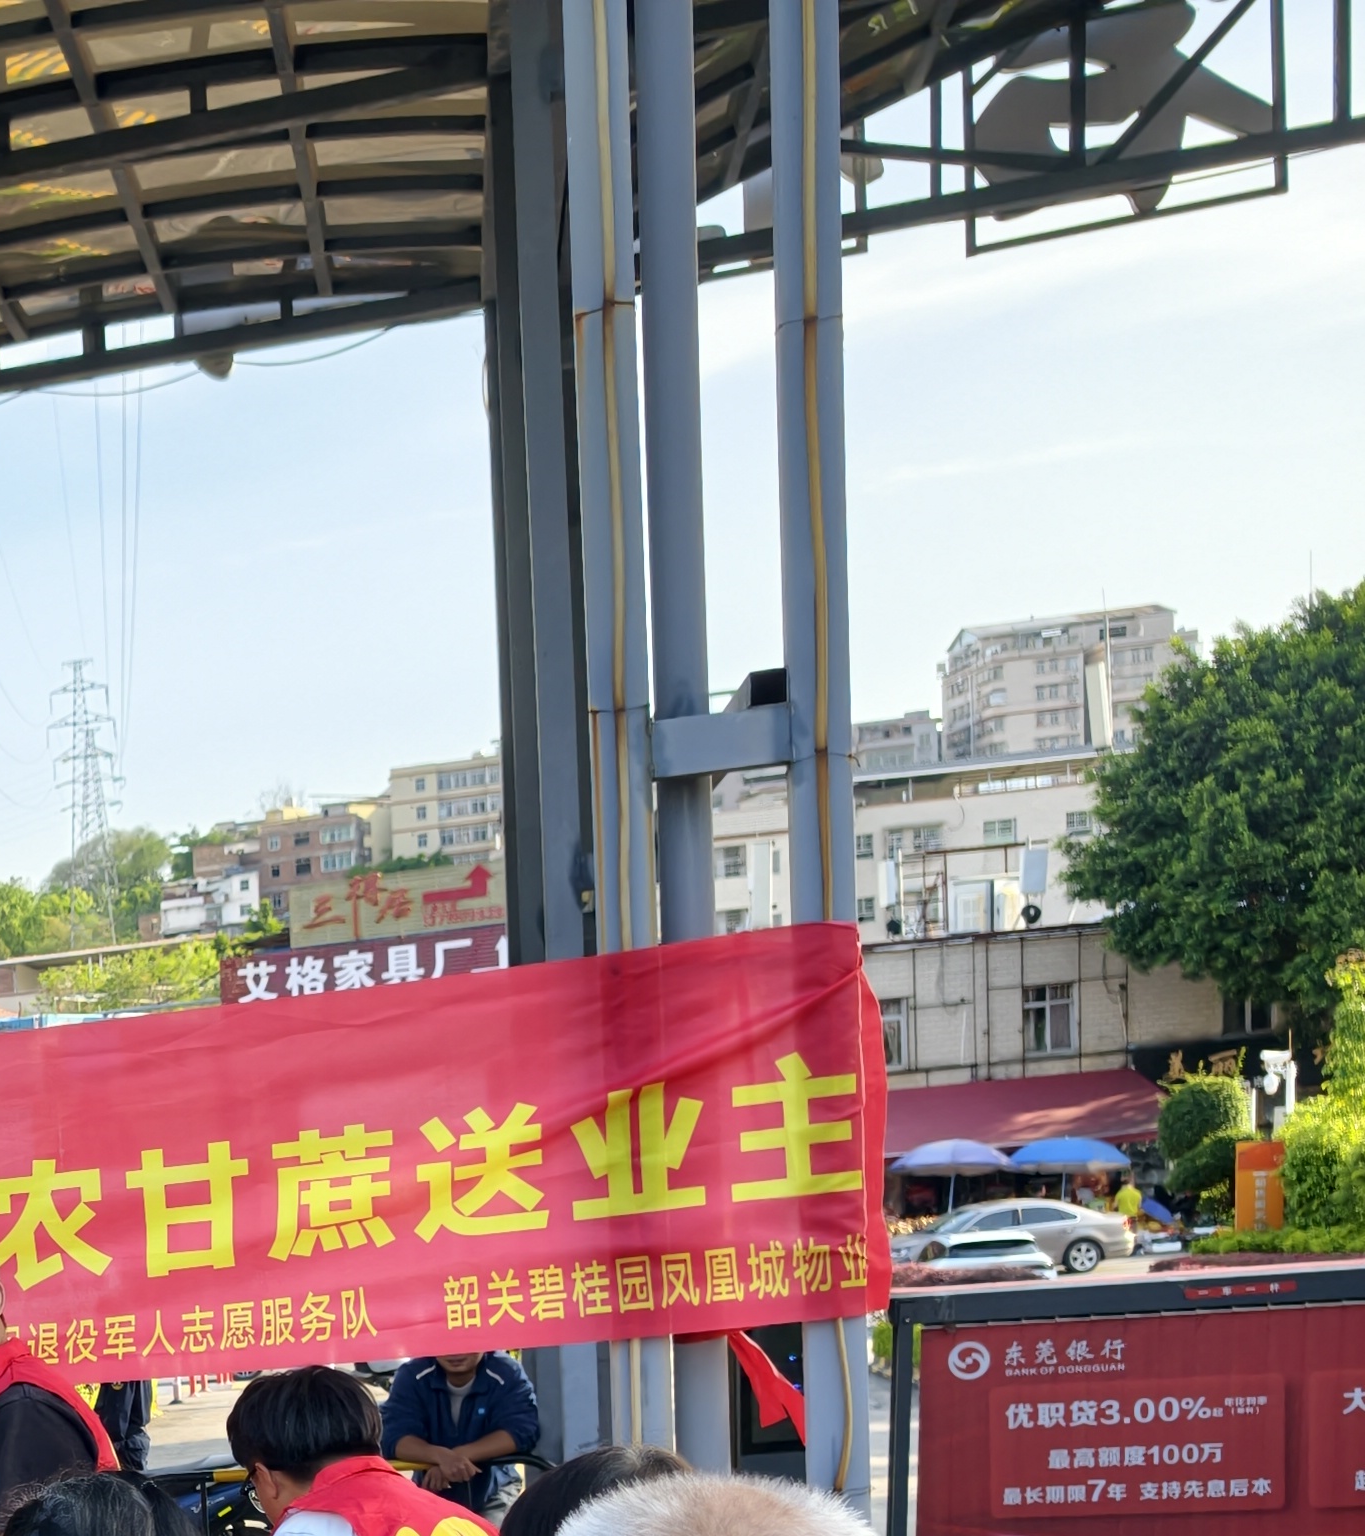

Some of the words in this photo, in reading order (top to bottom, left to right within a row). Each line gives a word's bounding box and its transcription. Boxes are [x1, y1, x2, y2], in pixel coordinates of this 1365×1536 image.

[237, 937, 473, 1004] 艾格家具厂
[443, 1233, 867, 1330] 韶关碧桂园凤凰城物业
[1004, 1339, 1126, 1366] 东莞银行
[1005, 1366, 1037, 1377] BANK
[1040, 1365, 1055, 1375] OF
[1058, 1362, 1125, 1374] DONGGUAN
[1048, 1442, 1224, 1470] 最高额度100万
[1003, 1479, 1127, 1505] 最长期限7年
[1139, 1477, 1272, 1501] 支持先息后本
